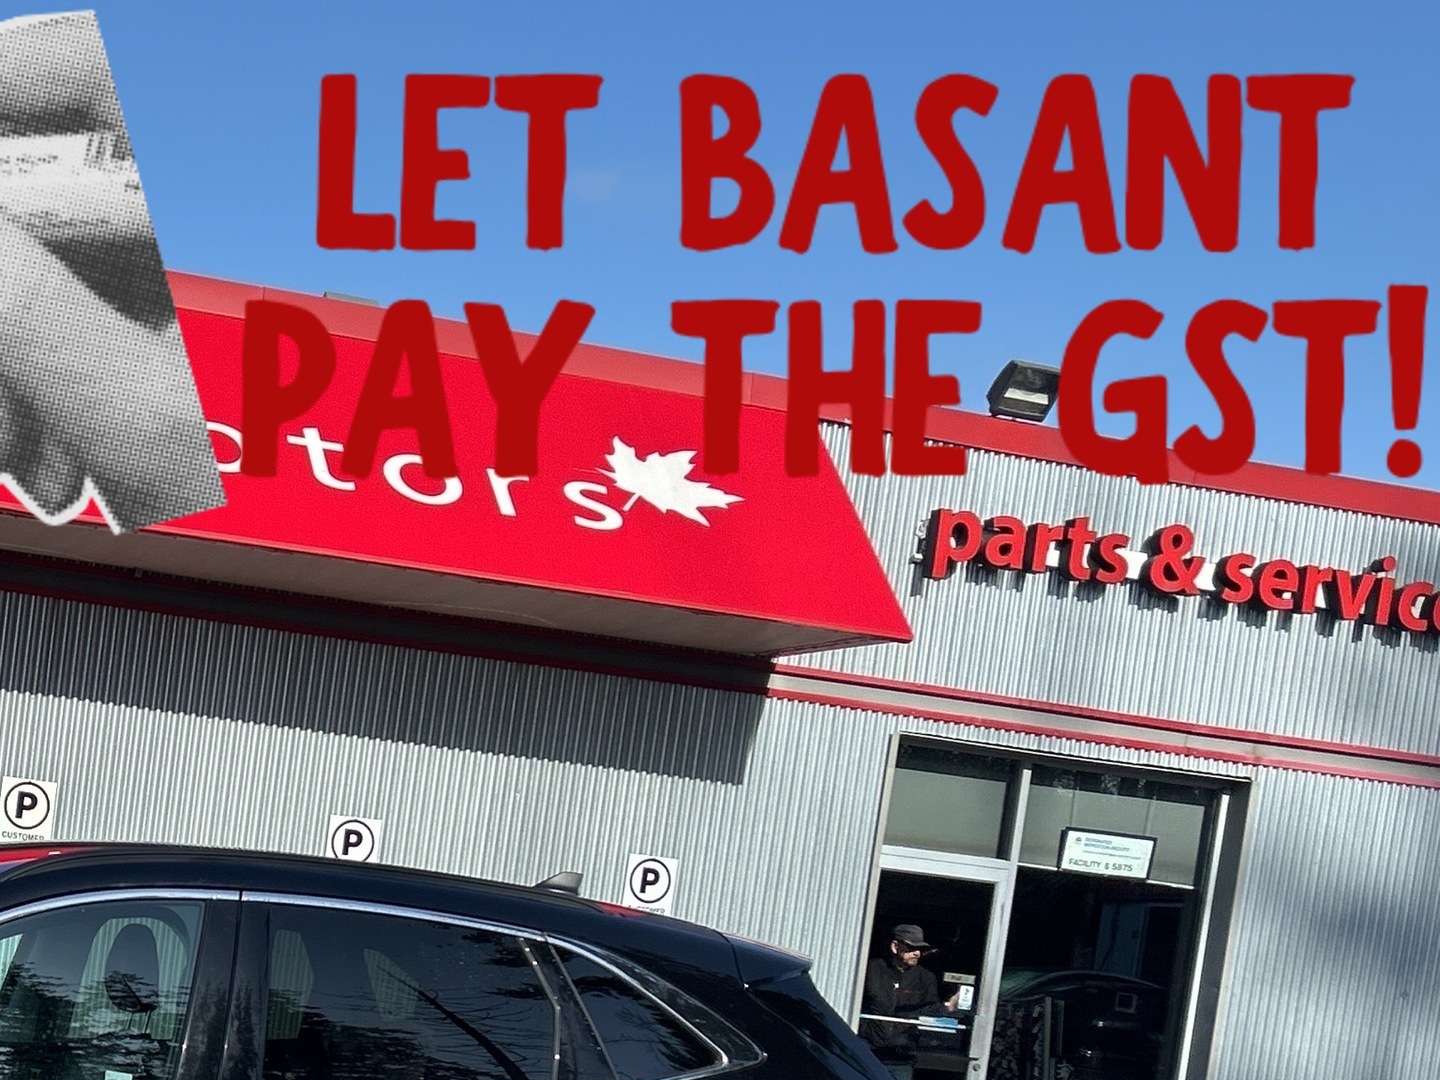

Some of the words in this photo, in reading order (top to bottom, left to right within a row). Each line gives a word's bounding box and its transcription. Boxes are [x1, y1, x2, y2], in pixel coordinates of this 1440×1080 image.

[206, 421, 623, 531] tors
[931, 507, 1131, 584] parts
[1149, 523, 1207, 597] &
[1220, 552, 1440, 633] servic
[15, 791, 38, 819] P
[342, 828, 363, 856] P
[640, 867, 660, 894] P
